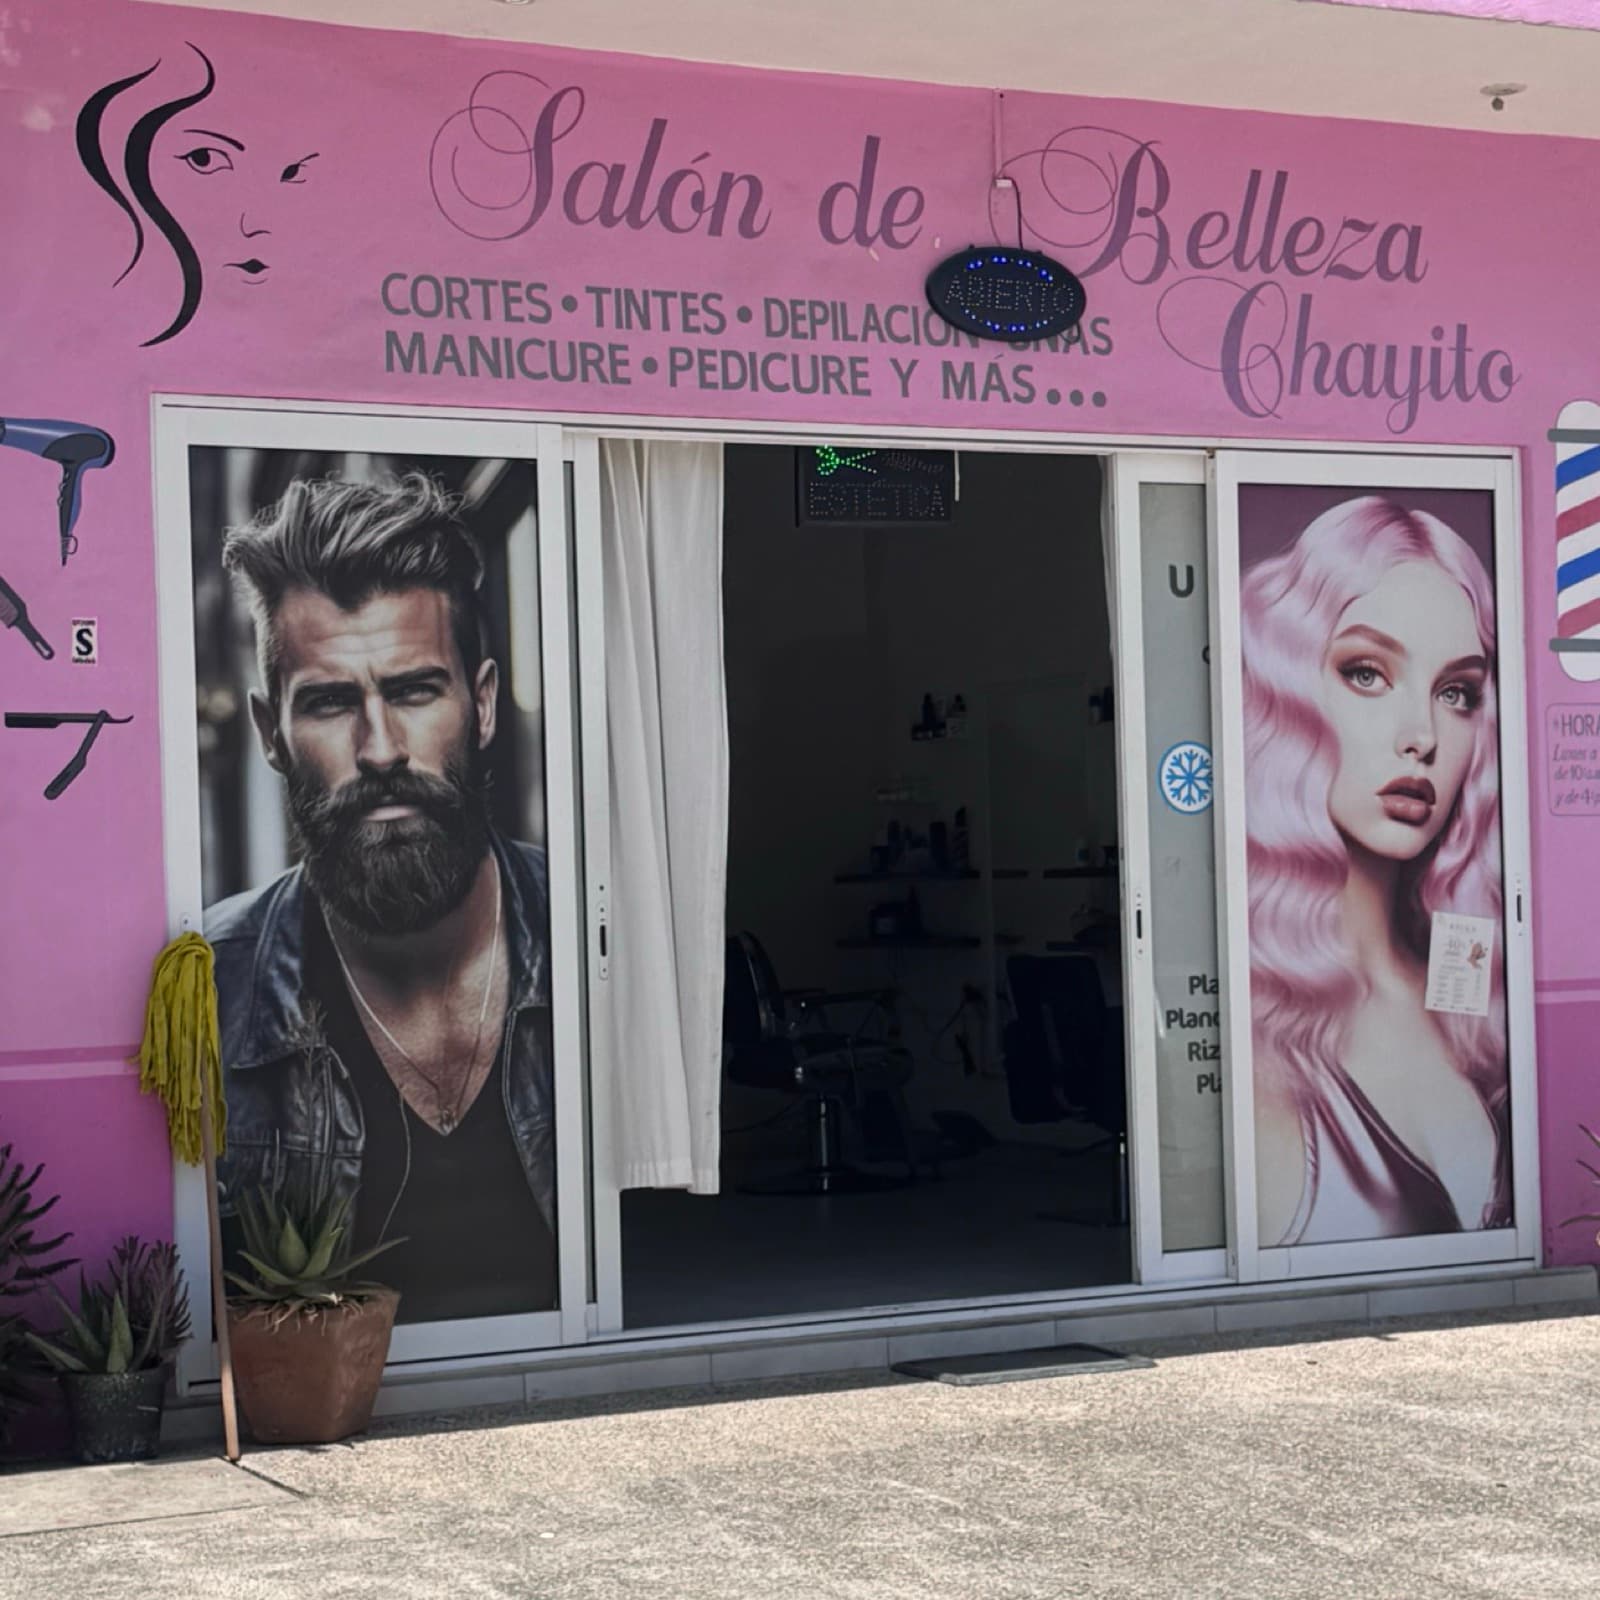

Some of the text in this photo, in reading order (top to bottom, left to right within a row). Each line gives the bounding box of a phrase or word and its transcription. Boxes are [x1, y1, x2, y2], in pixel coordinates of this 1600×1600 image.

[429, 70, 1428, 285] Salón de Belleza
[380, 272, 553, 325] CORTES
[585, 285, 727, 335] TINTES
[944, 274, 1074, 315] ABIERTO
[385, 330, 632, 385] MANICURE
[669, 348, 871, 397] PEDICURE
[889, 358, 919, 398] Y
[1157, 276, 1522, 434] Chayito
